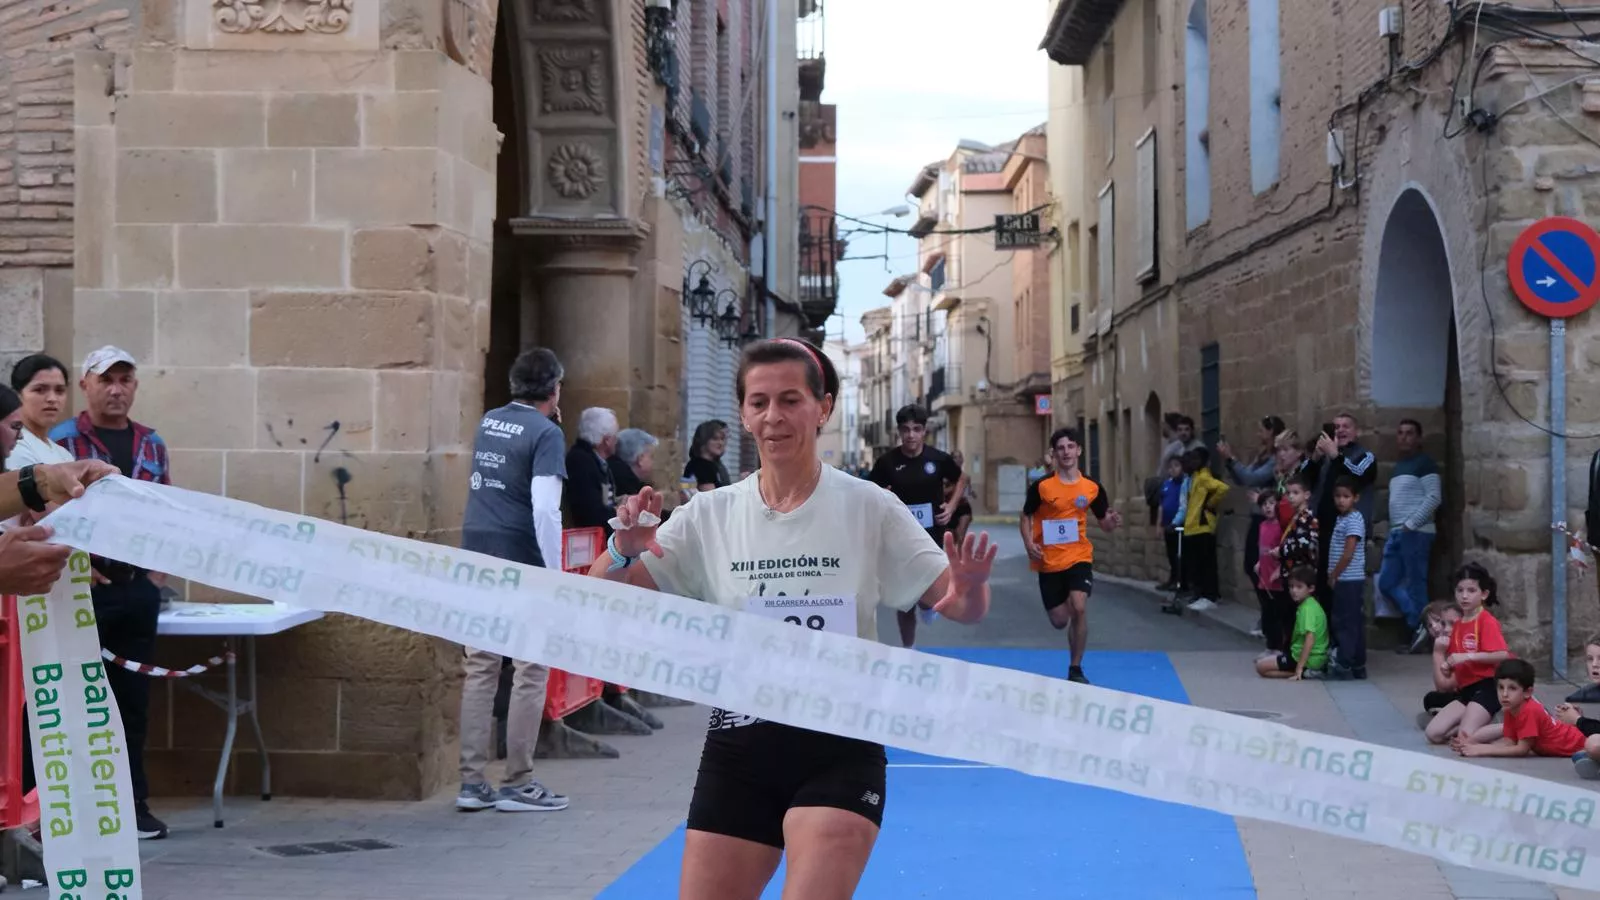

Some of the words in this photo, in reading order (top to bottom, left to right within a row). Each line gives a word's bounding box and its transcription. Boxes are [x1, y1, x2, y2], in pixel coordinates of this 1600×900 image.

[481, 417, 525, 435] SPEAKER
[1058, 524, 1066, 535] 8
[731, 560, 755, 572] XIII
[758, 554, 818, 570] EDICIÓN
[822, 557, 840, 568] 5K
[749, 572, 783, 580] ALCOLEA
[764, 599, 776, 607] XIII
[776, 598, 810, 607] CARRERA
[811, 597, 844, 606] ALCOLEA
[32, 662, 74, 839] Bantierra
[80, 661, 122, 836] Bantierra
